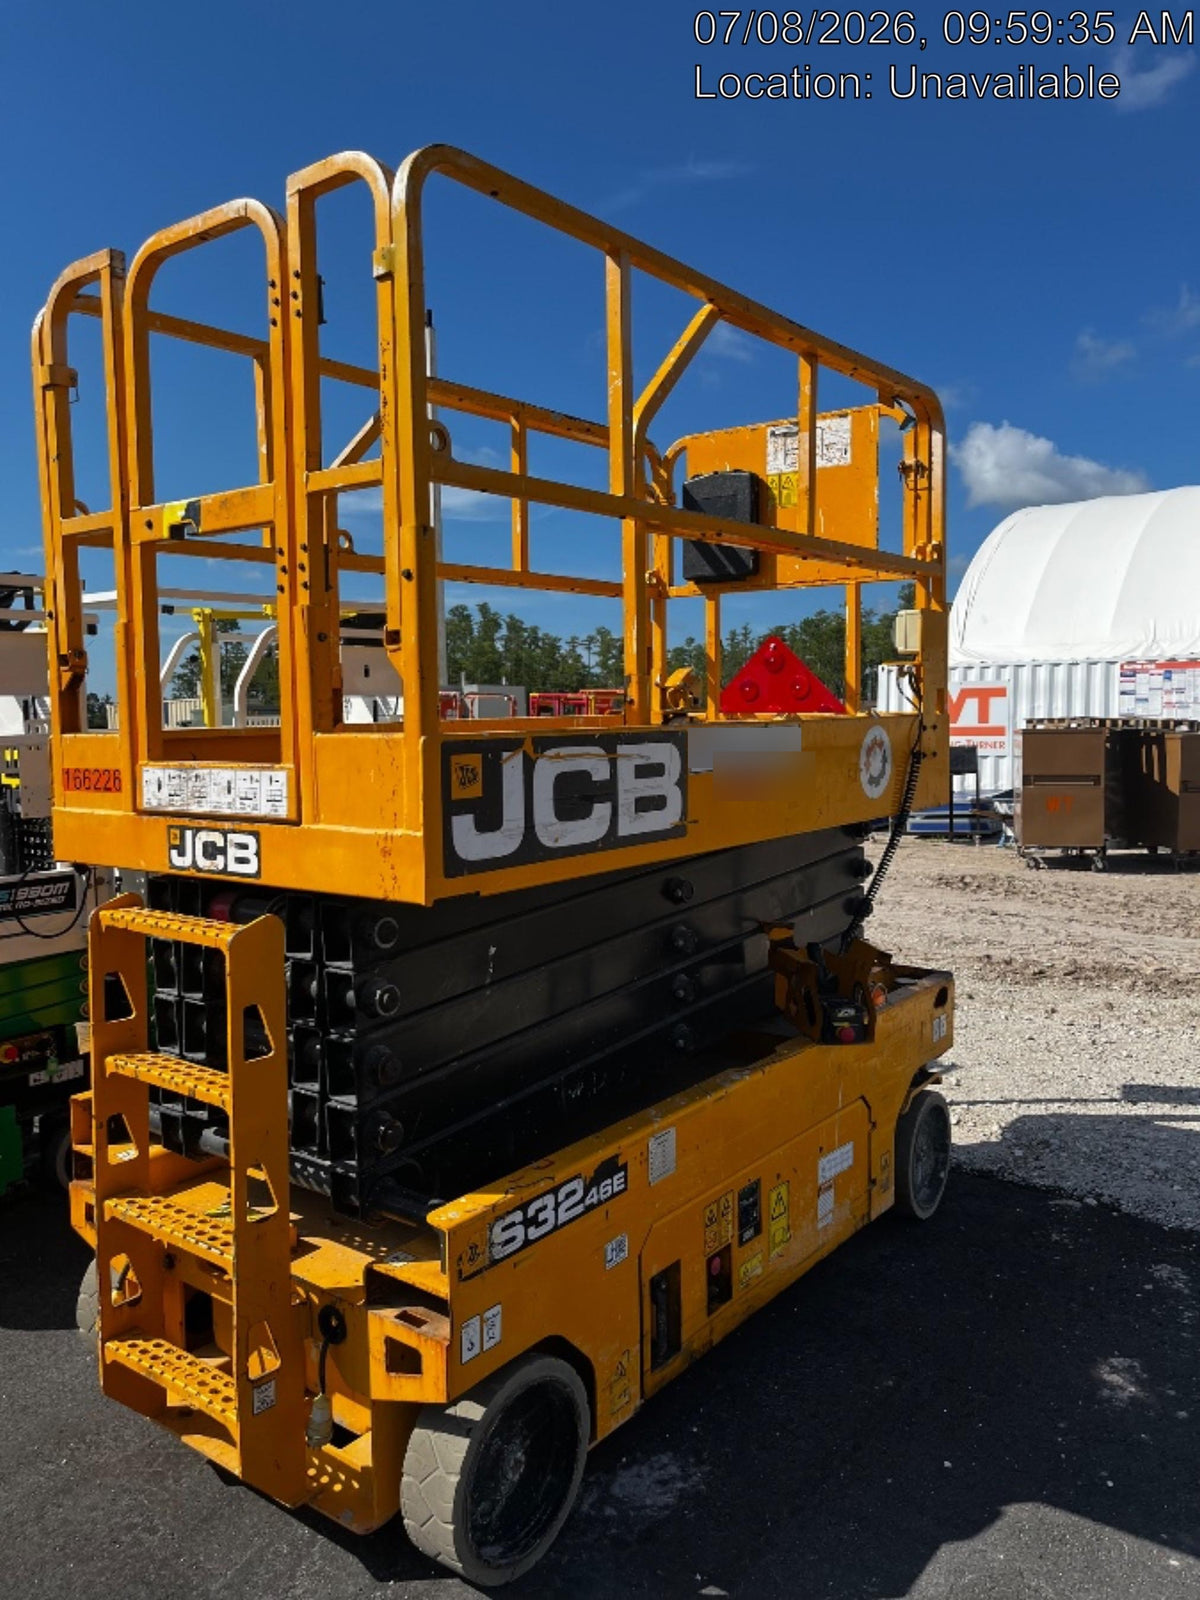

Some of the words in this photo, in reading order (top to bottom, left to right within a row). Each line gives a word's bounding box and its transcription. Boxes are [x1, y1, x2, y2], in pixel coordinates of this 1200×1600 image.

[64, 768, 121, 792] 166226
[452, 742, 681, 862] JCB
[169, 829, 258, 874] JCB
